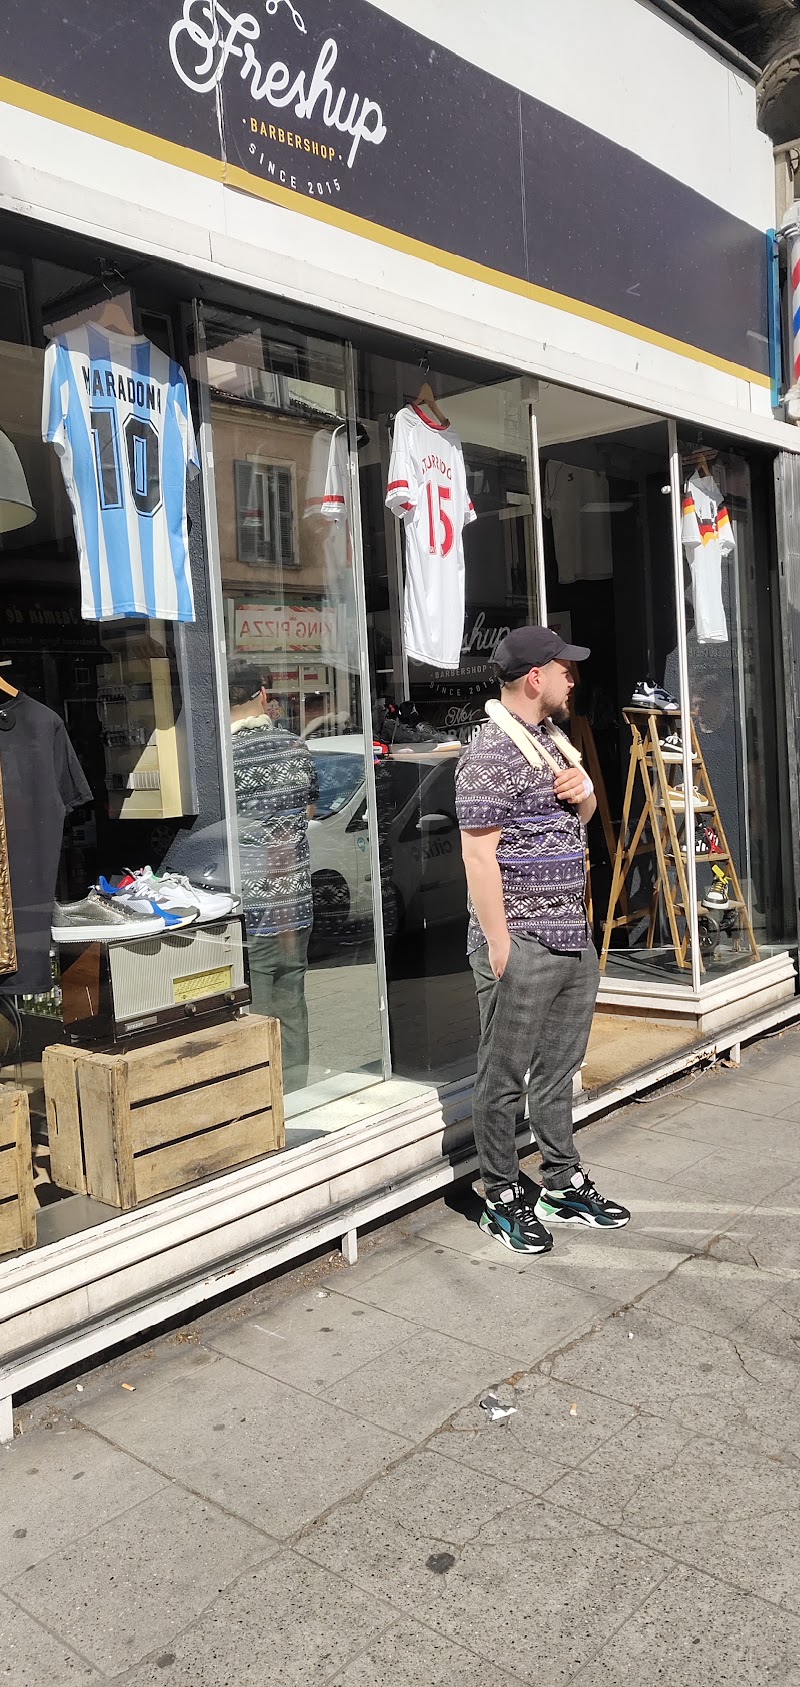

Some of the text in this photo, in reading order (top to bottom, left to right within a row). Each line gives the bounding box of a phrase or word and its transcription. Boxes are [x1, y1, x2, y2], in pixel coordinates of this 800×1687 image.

[169, 0, 387, 168] Freshup
[250, 117, 335, 161] BARBERSHOP
[248, 142, 341, 195] SINCE 2015
[89, 405, 163, 518] 10
[426, 480, 455, 558] 15
[430, 676, 495, 696] SINCE 2015
[435, 664, 487, 679] BARBERSHOP
